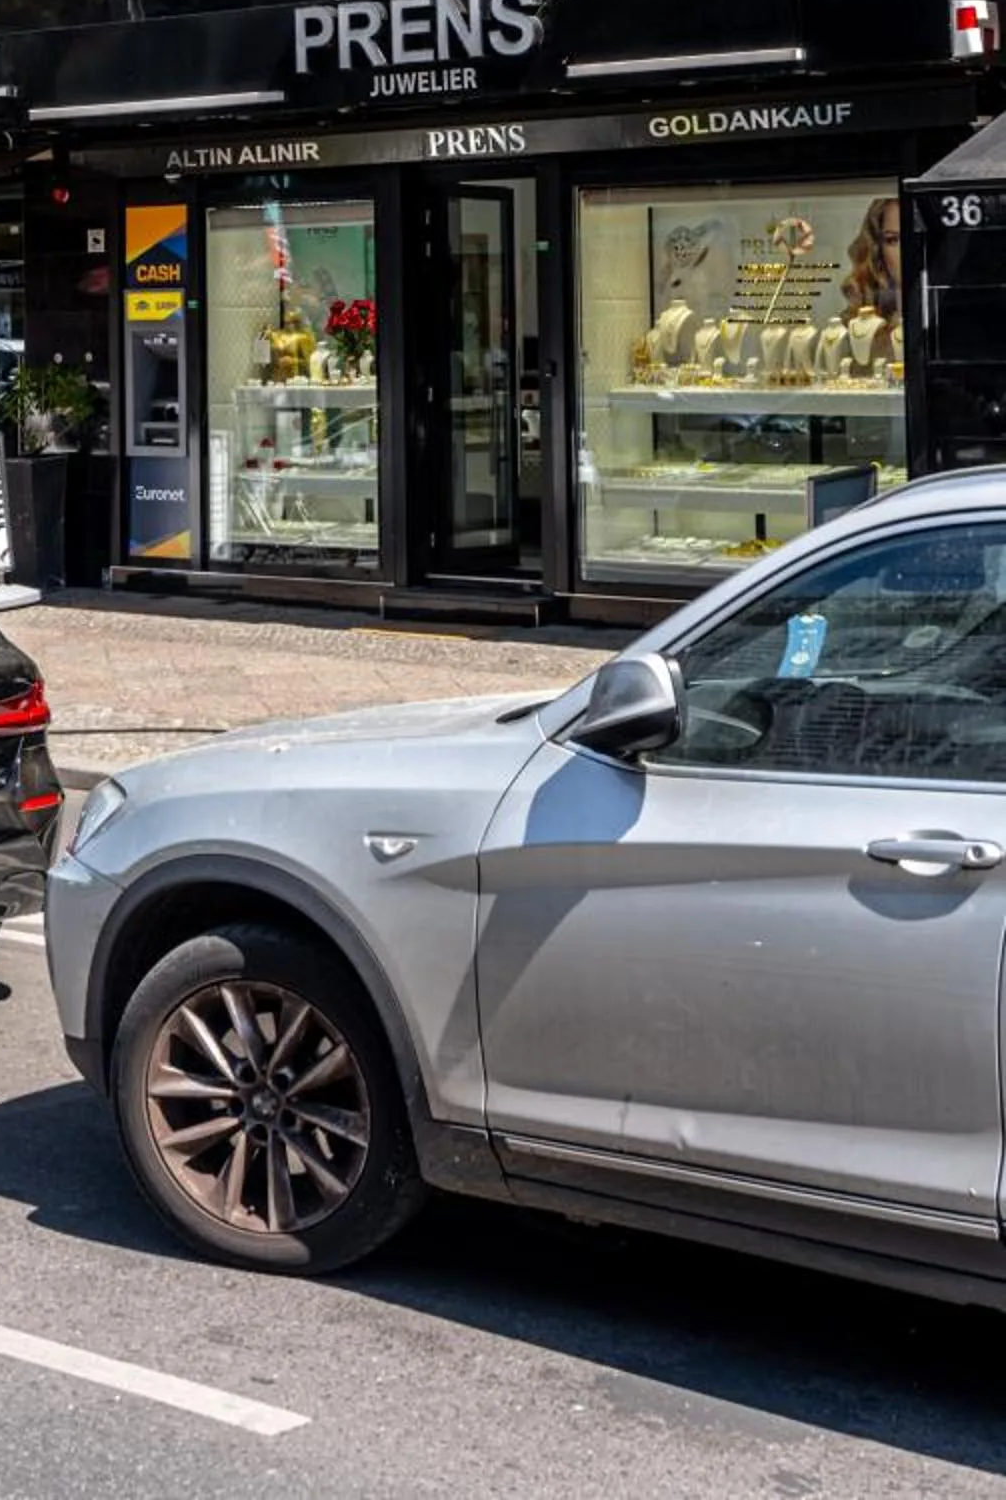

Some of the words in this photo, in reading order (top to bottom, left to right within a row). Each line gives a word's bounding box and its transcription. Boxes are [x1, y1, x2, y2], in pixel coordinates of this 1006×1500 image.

[370, 67, 478, 97] JUWELIER
[648, 102, 852, 139] GOLDANKAUF
[166, 146, 232, 169] ALTIN
[237, 141, 320, 165] ALINIR
[427, 125, 526, 157] PRENS
[941, 195, 983, 228] 36
[136, 264, 181, 282] CASH
[135, 485, 186, 502] Euronet
